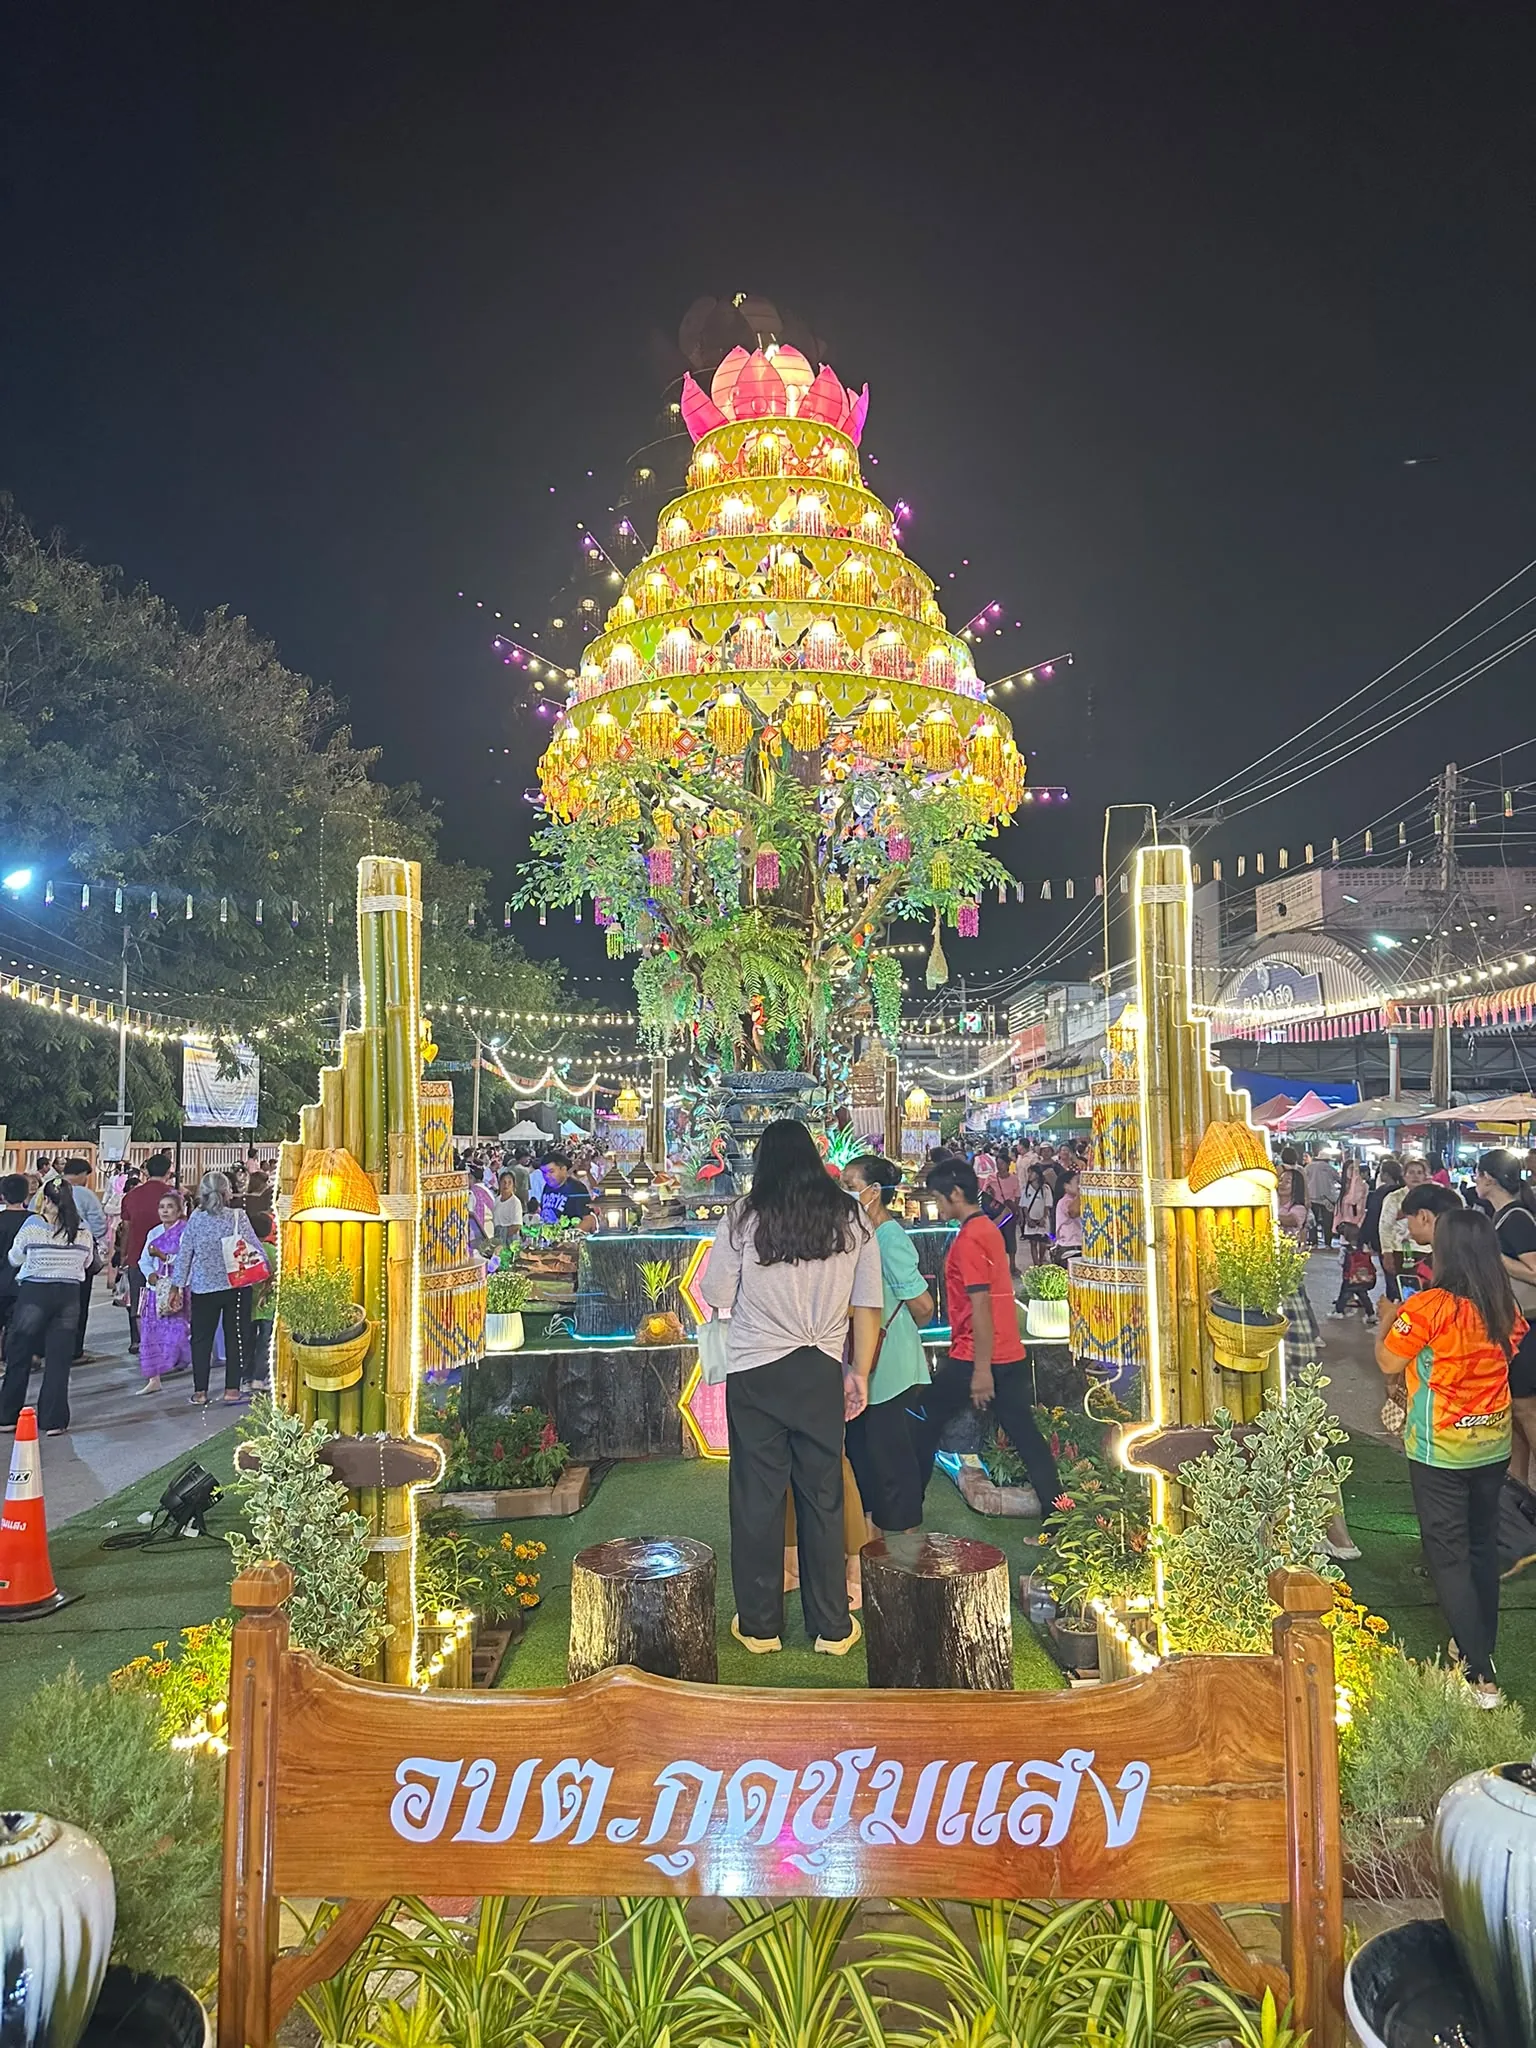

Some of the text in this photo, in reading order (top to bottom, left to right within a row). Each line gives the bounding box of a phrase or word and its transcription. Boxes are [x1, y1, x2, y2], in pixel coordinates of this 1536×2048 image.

[390, 1746, 1150, 1877] อบต.กุดชุมแสง
